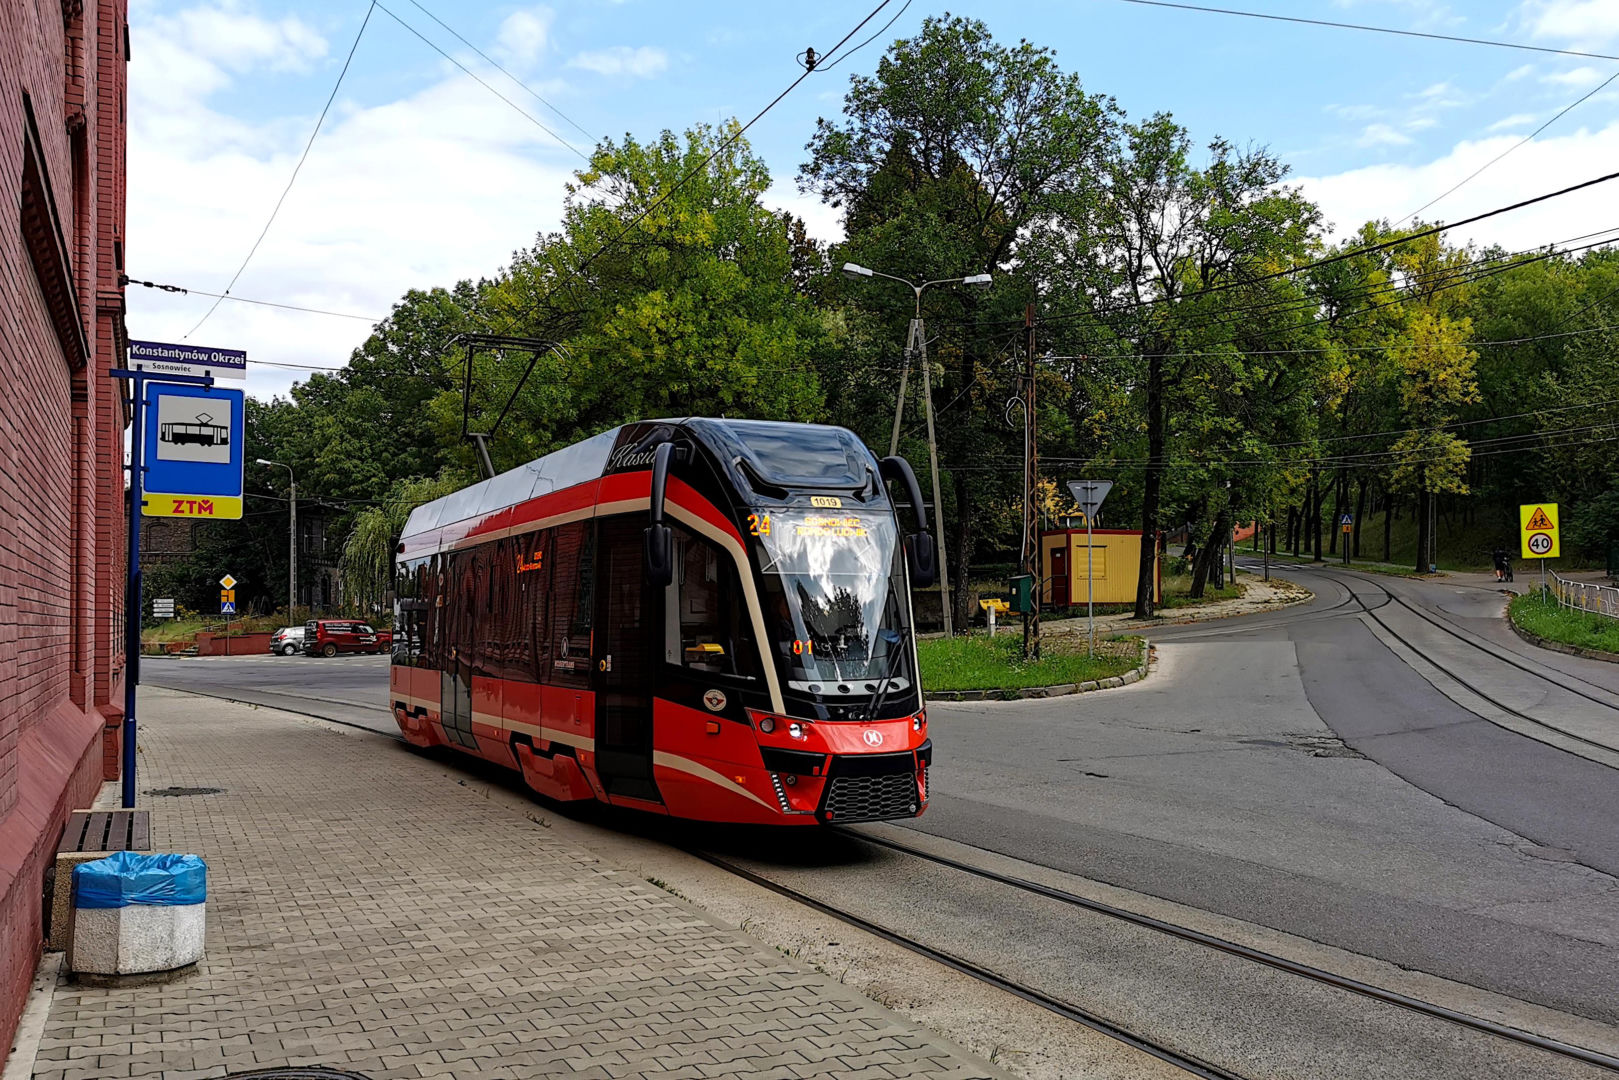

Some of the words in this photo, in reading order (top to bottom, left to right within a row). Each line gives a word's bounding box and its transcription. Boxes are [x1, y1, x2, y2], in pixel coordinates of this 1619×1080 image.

[132, 344, 208, 361] Konstantynów
[210, 351, 245, 365] Okrzei
[152, 362, 191, 373] Sosnowiec
[172, 499, 213, 514] ZTM
[814, 498, 838, 507] 1019
[747, 514, 770, 536] 24
[1531, 538, 1549, 549] 40
[793, 639, 813, 655] 01
